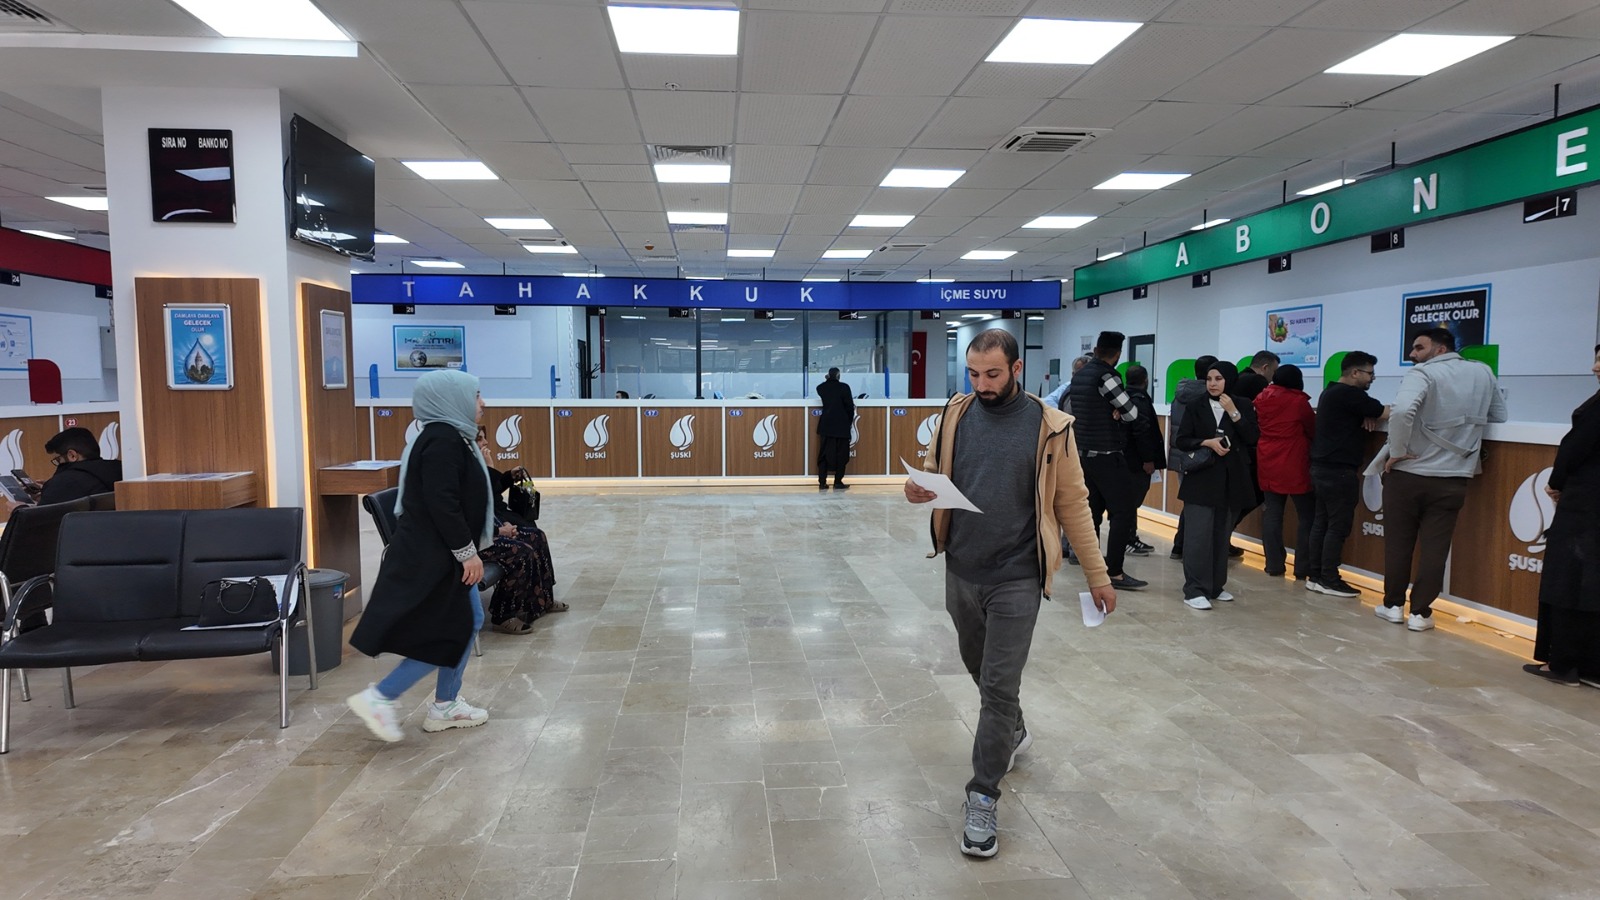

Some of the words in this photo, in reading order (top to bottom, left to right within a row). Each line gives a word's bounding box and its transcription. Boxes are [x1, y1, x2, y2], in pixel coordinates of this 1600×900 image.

[161, 137, 176, 148] SIRA
[177, 137, 187, 148] NO
[198, 137, 219, 148] BANKO
[220, 138, 228, 148] NO
[1561, 198, 1571, 211] 7
[1393, 233, 1398, 243] 8
[1281, 258, 1287, 267] 9
[403, 281, 814, 302] TAHAKKUK
[940, 287, 970, 302] İÇME
[973, 289, 1007, 299] SUYU
[1414, 303, 1443, 312] DAMLAYA
[1444, 300, 1475, 309] DAMLAYA
[1410, 311, 1451, 324] GELECEK
[1452, 308, 1480, 320] OLUR
[497, 451, 519, 460] ŞUSKİ
[585, 451, 606, 460] ŞUSKİ
[670, 451, 691, 459] ŞUSKİ
[753, 450, 774, 458] ŞUSKİ
[1362, 521, 1384, 537] ŞUS
[1508, 553, 1543, 574] ŞUSK
